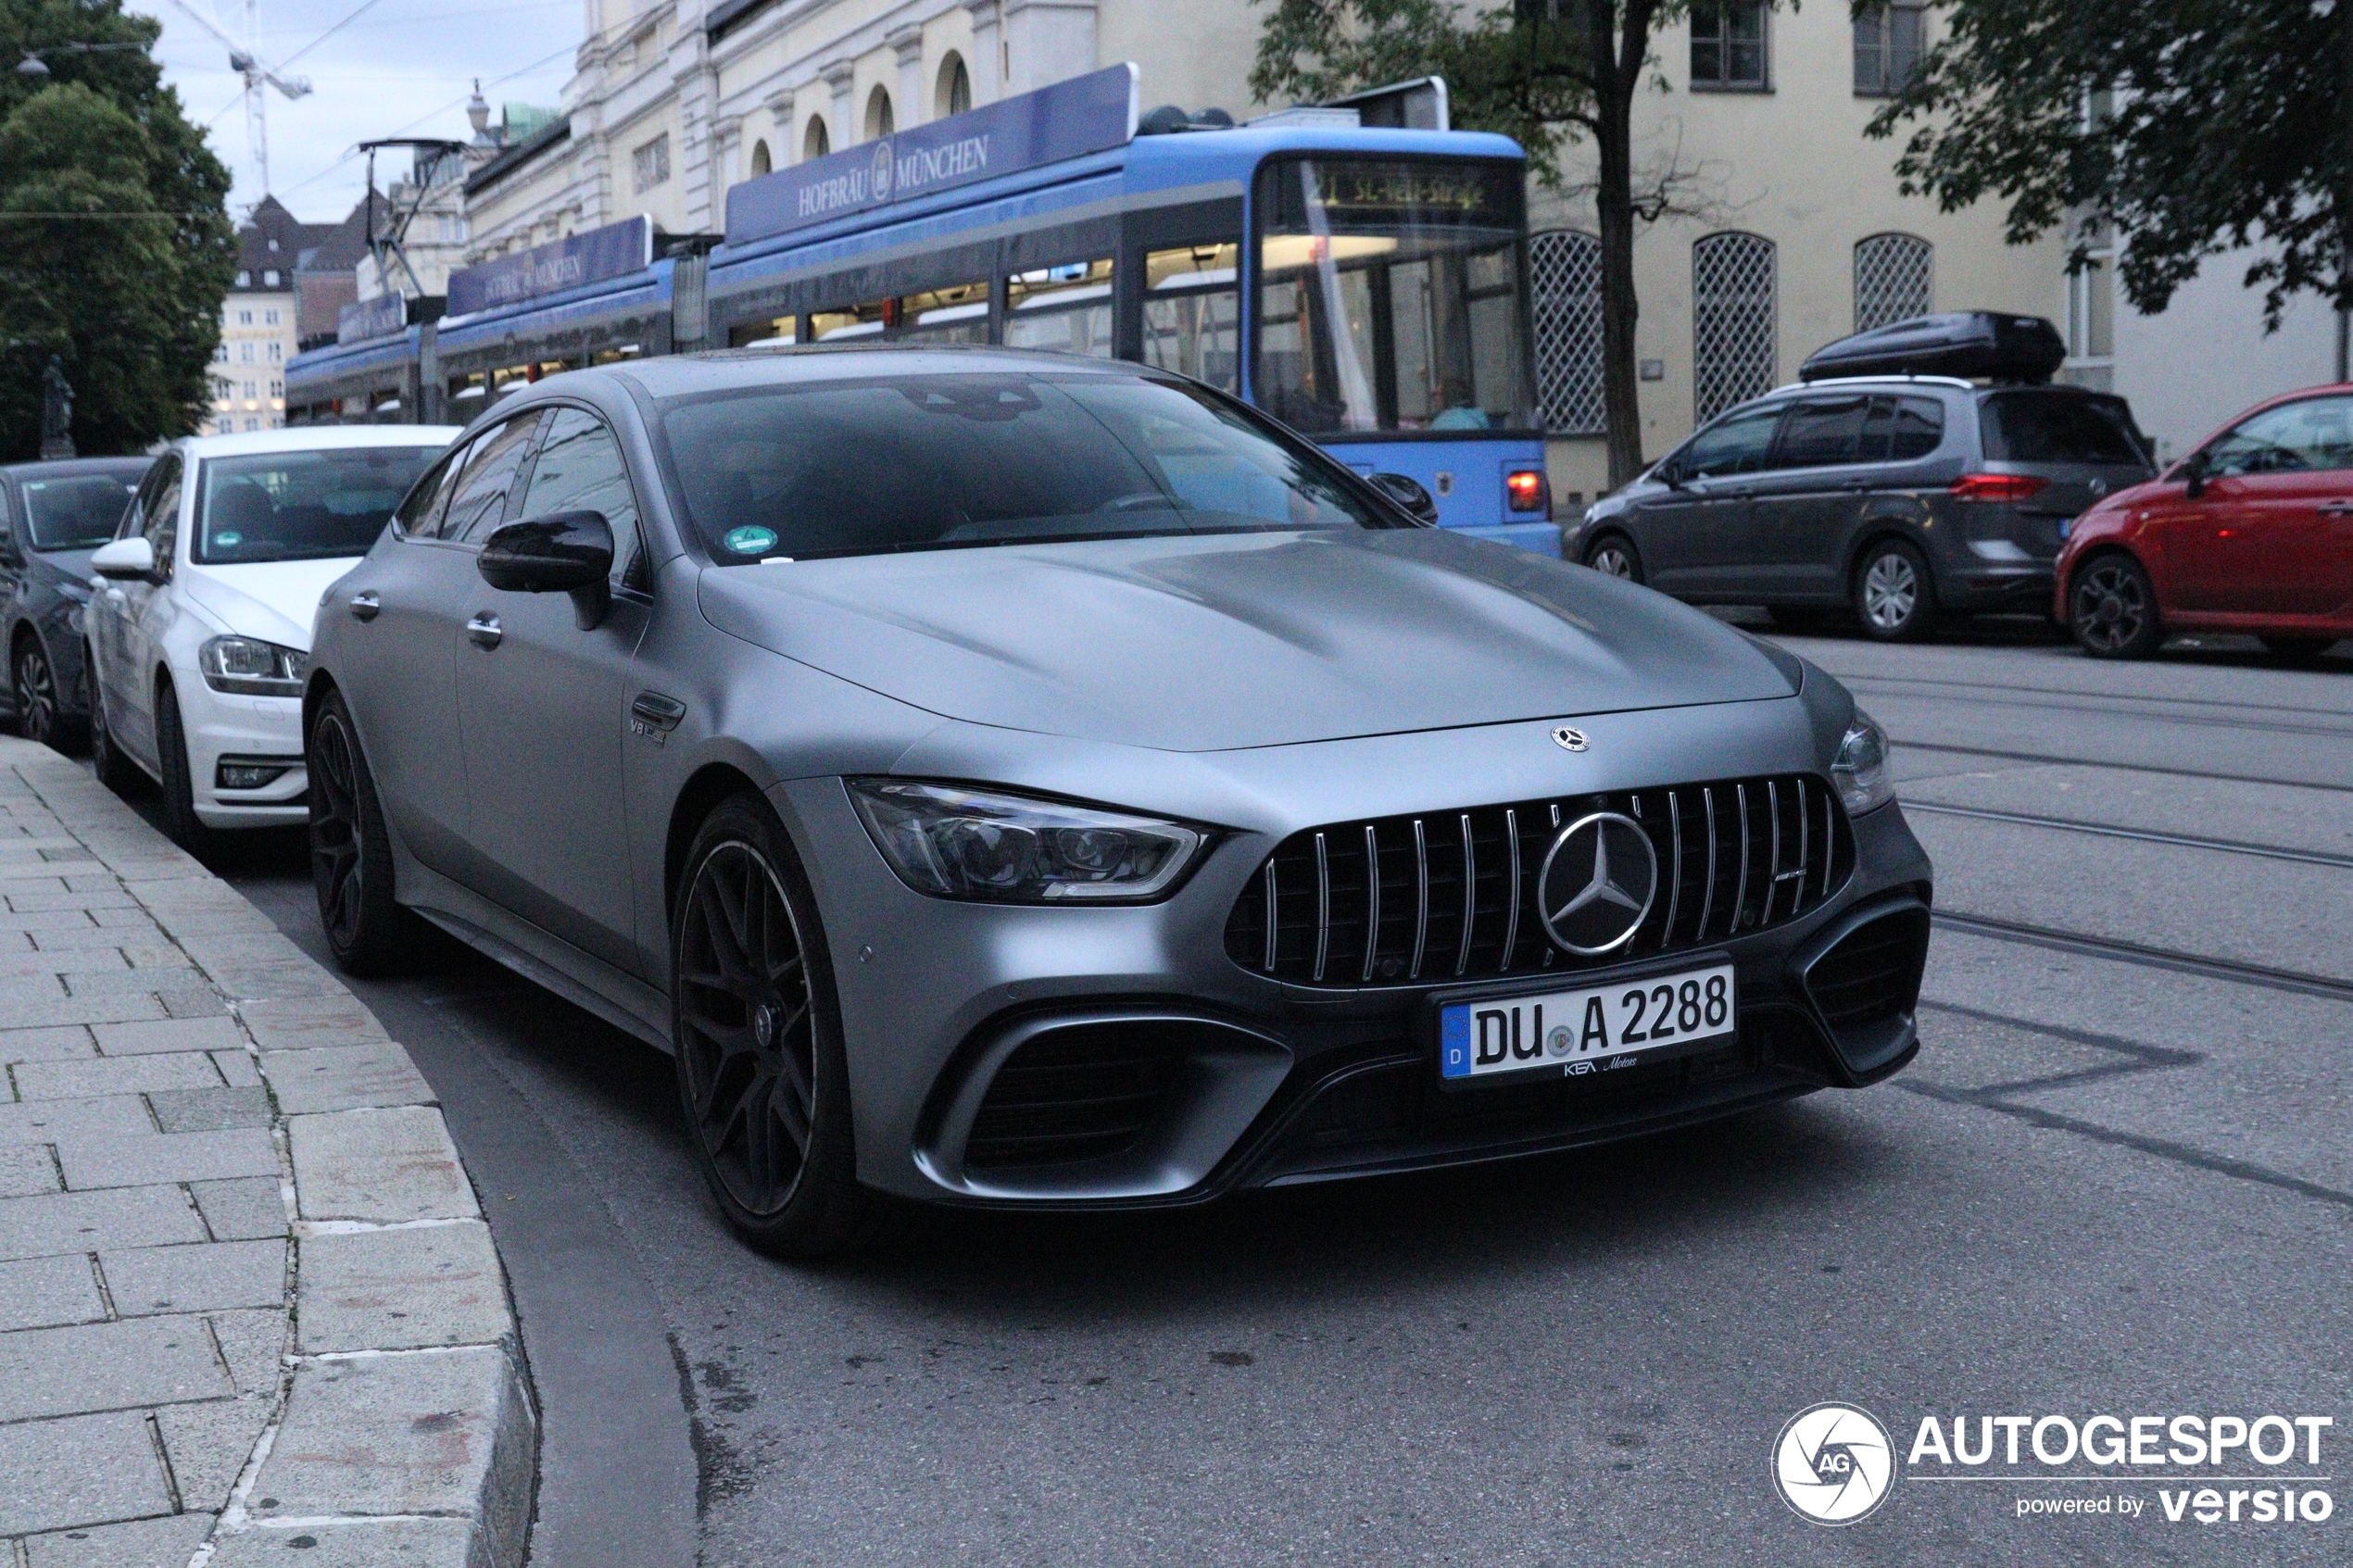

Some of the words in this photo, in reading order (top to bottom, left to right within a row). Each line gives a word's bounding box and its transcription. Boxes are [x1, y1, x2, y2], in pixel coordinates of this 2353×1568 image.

[799, 169, 871, 218] HOFBRÄU
[896, 134, 989, 192] MÜNCHEN
[630, 719, 645, 735] V8
[1475, 1003, 1543, 1066] DU
[1579, 996, 1609, 1052] A
[1620, 974, 1729, 1046] 2288
[1450, 1048, 1462, 1066] D
[1564, 1060, 1597, 1077] KEA
[1603, 1055, 1638, 1072] Motors
